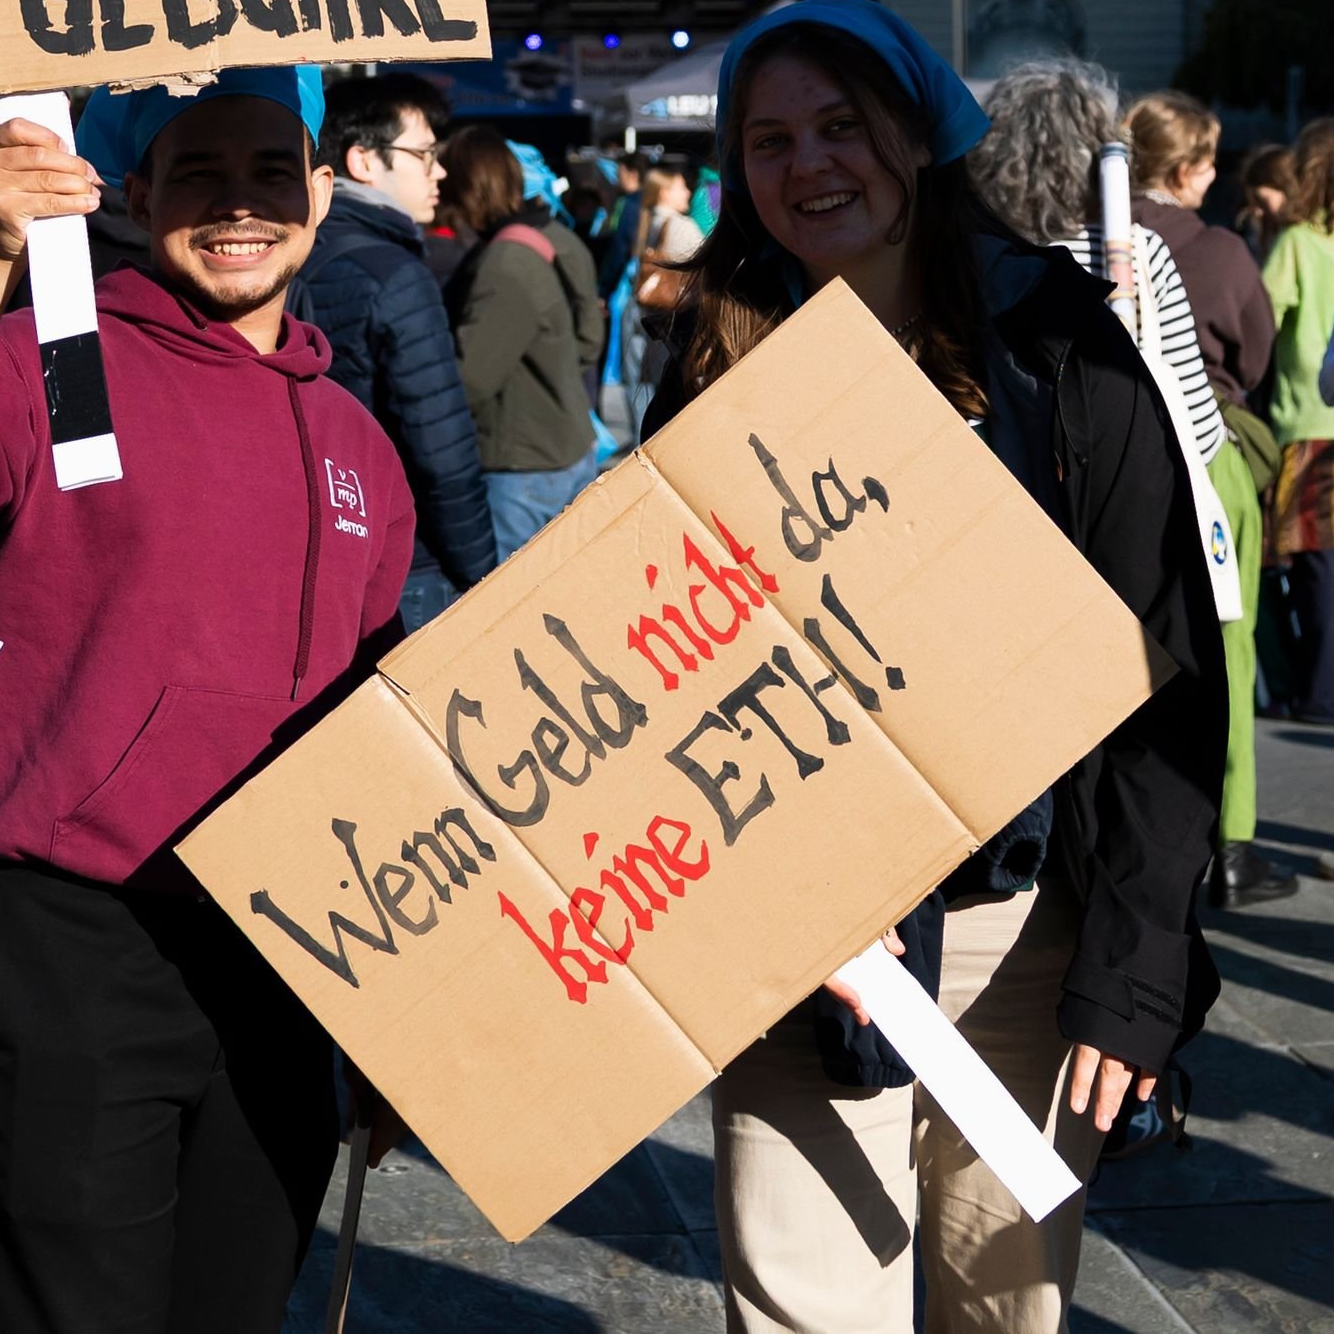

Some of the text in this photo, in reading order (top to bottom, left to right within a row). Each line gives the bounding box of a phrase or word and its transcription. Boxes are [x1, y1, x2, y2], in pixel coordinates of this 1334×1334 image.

[250, 431, 890, 988] Wenn Geld nicht da,
[497, 573, 907, 1005] keine ETH!
